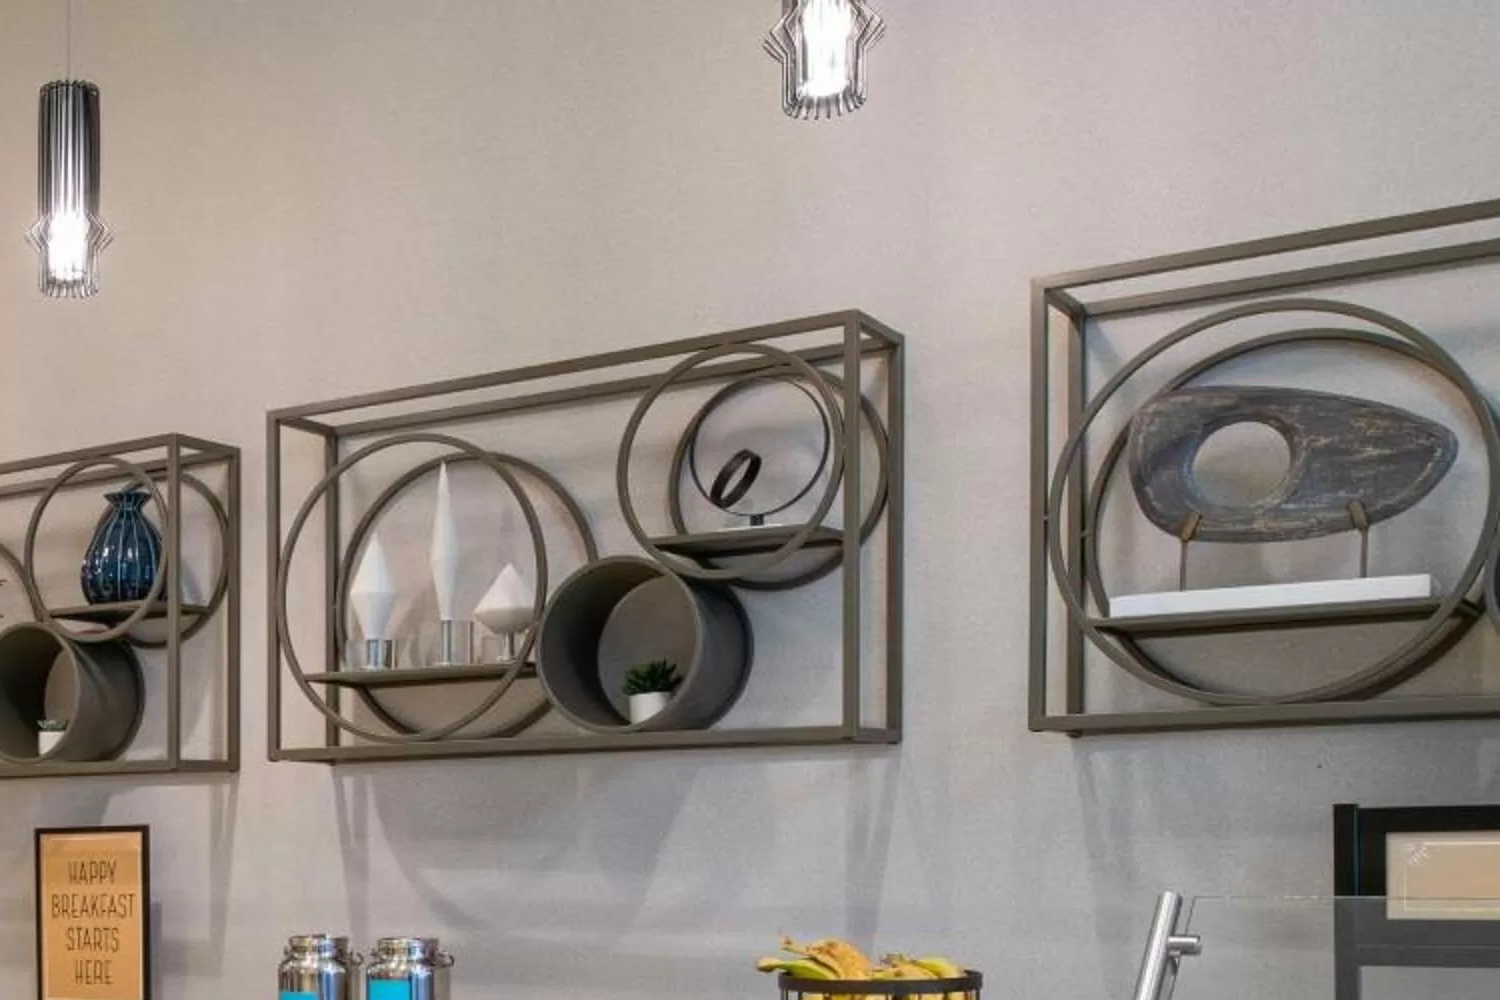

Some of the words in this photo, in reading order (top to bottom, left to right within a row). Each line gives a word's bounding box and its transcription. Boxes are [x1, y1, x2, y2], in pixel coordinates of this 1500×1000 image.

[67, 859, 117, 885] HAPPY
[51, 893, 136, 919] BREAKFAST
[66, 926, 120, 953] STARTS
[74, 959, 114, 985] HERE
